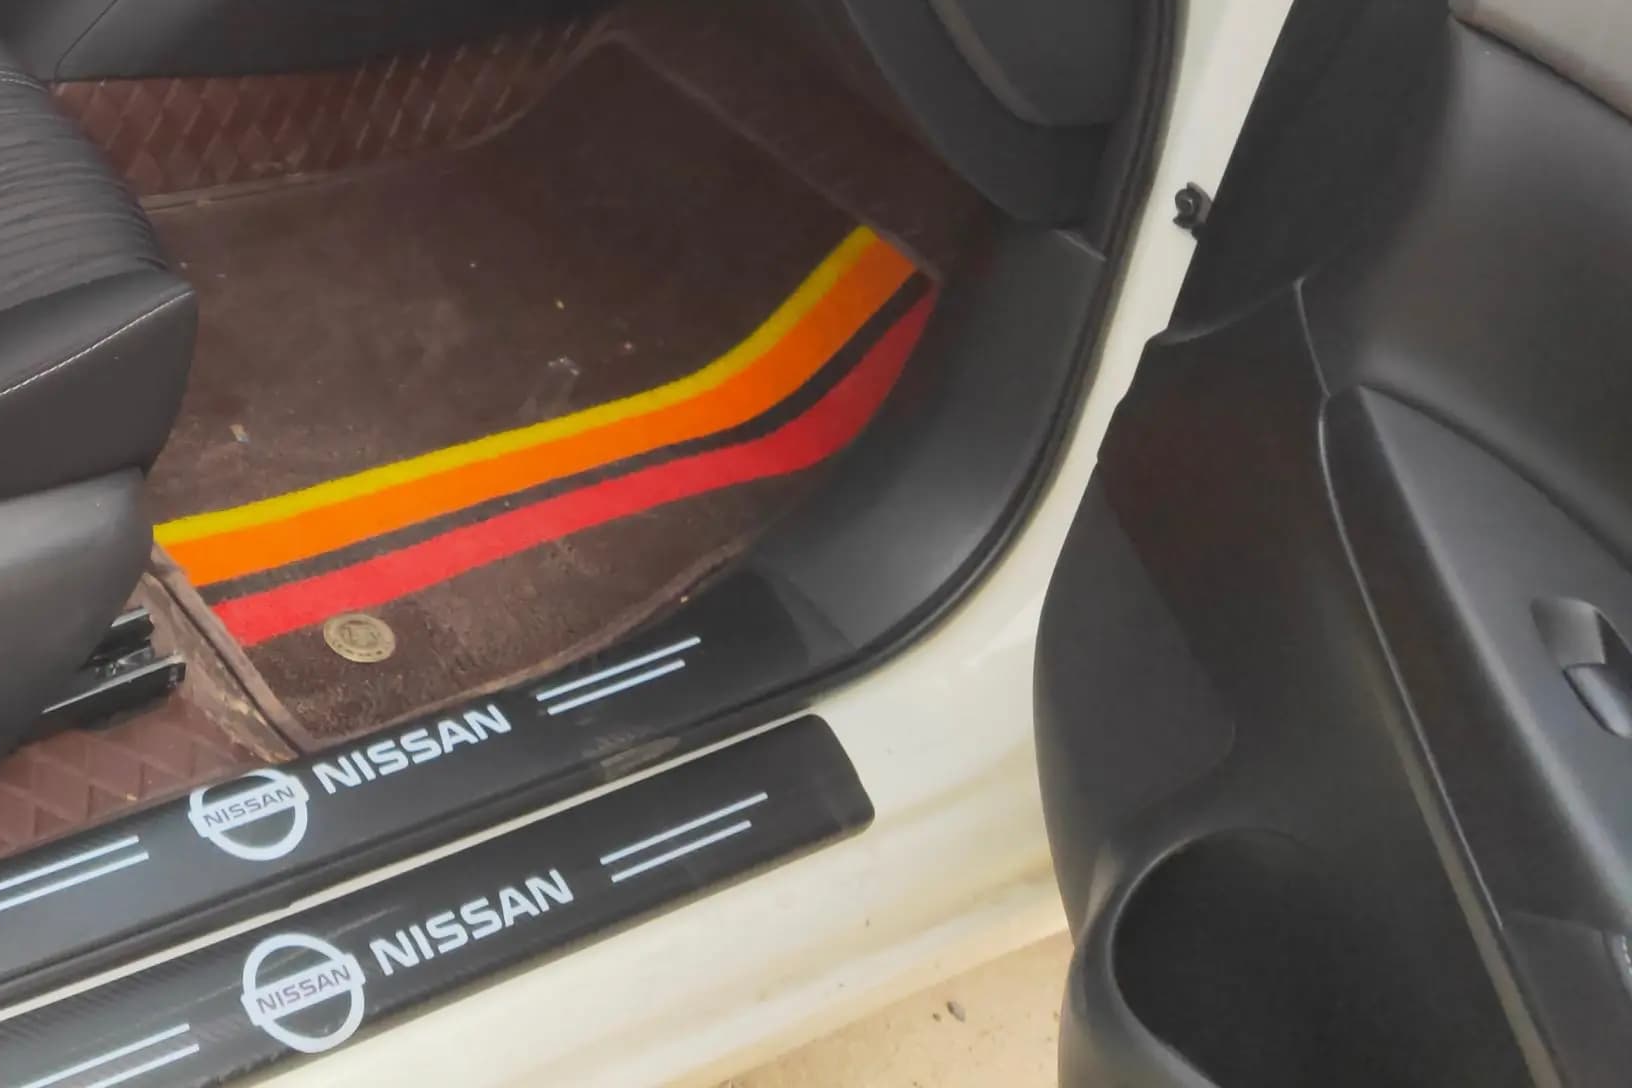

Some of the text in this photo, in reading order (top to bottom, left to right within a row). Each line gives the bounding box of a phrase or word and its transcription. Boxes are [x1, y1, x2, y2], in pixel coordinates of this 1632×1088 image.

[312, 704, 512, 794] NISSAN
[202, 785, 296, 828] NISSAN
[369, 869, 573, 976] NISSAN
[255, 964, 352, 1015] NISSAN
